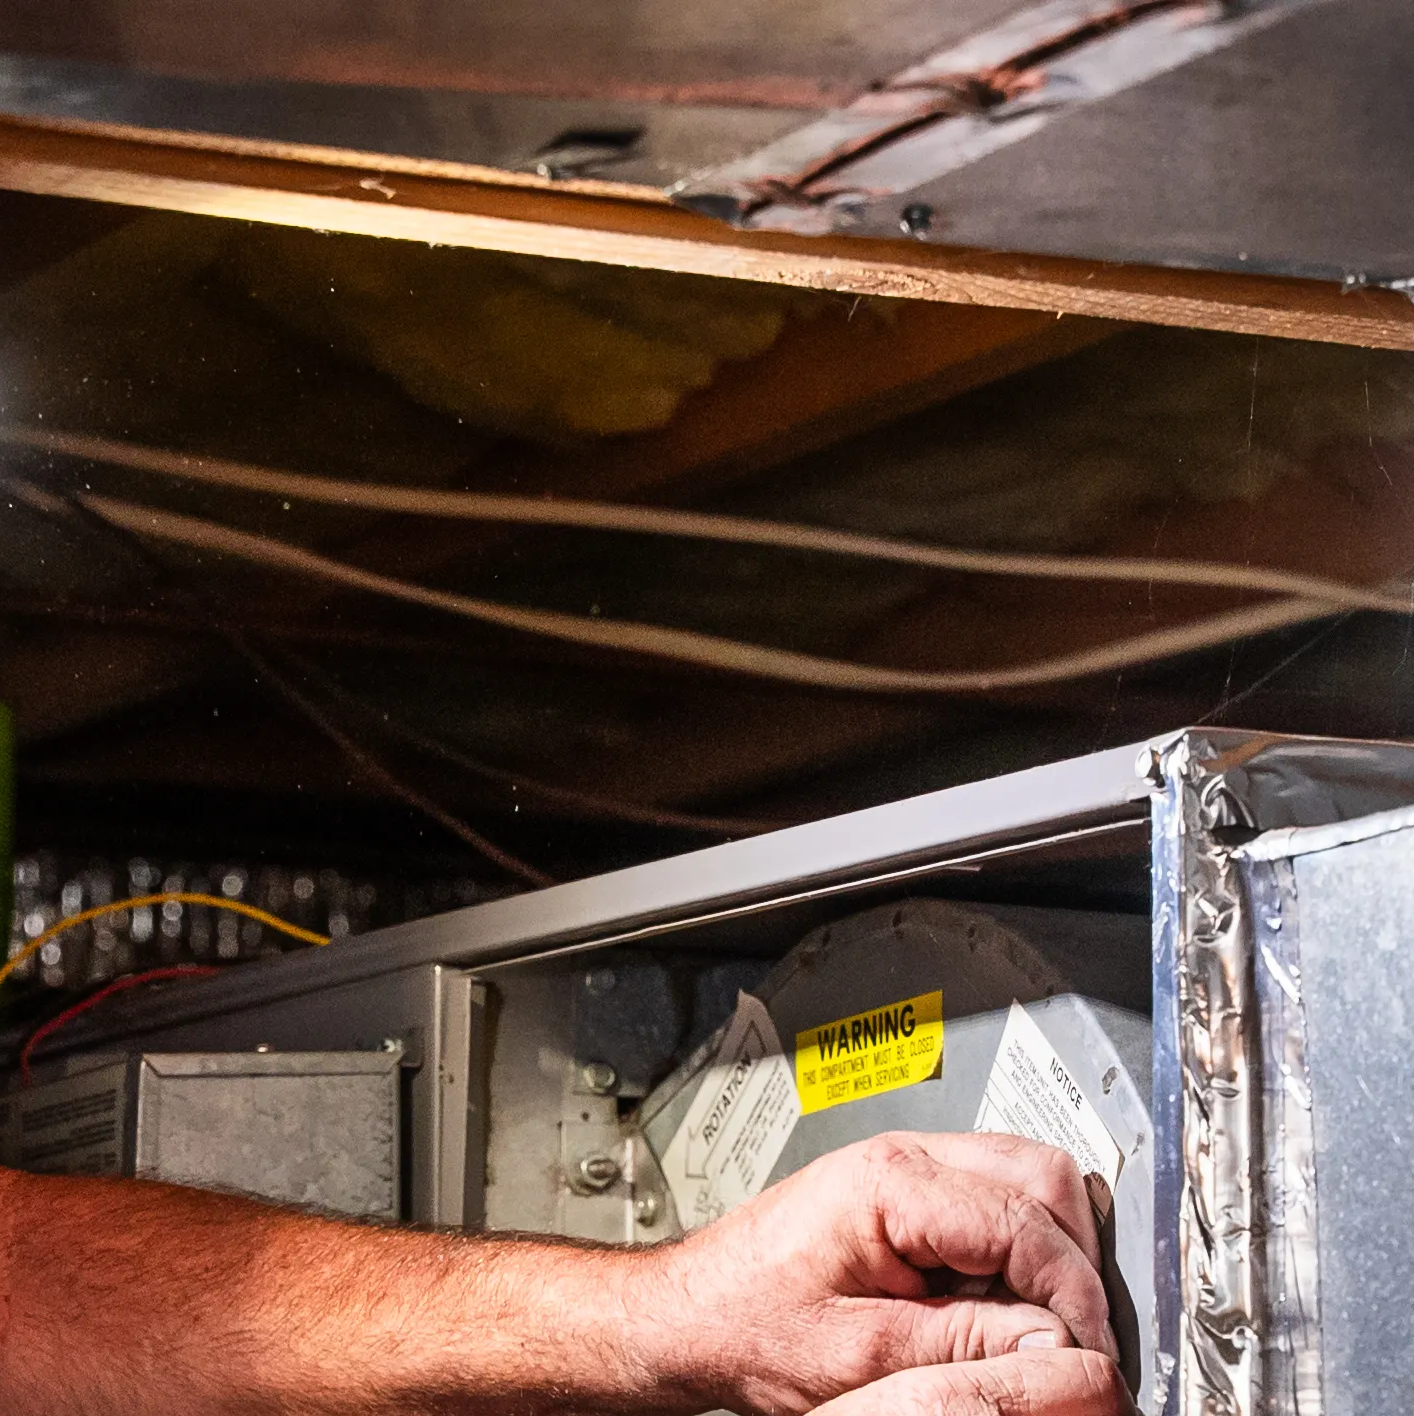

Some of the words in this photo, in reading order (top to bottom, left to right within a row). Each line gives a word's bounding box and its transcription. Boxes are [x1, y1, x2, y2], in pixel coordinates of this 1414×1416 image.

[803, 1069, 816, 1087] THIS
[820, 1055, 868, 1082] COMPARTMENT
[873, 1048, 891, 1067] MUST
[897, 1044, 906, 1061] BE
[910, 1036, 935, 1057] CLOSED
[817, 1004, 916, 1062] WARNING
[702, 1051, 752, 1146] ROTATION
[827, 1080, 849, 1100] EXCEPT
[853, 1074, 872, 1093] WHEN
[875, 1063, 909, 1087] SERVICING
[1007, 1047, 1030, 1082] CHECKED
[1029, 1079, 1040, 1096] FOR
[1040, 1093, 1076, 1148] CONFORMANCE
[1076, 1146, 1084, 1160] TO
[1011, 1070, 1022, 1088] AND
[1022, 1086, 1054, 1134] ENGINEERING
[1014, 1039, 1025, 1059] THIS
[1049, 1092, 1060, 1108] HAS
[1060, 1105, 1076, 1128] BEEN
[1074, 1125, 1106, 1172] THOROUGHLY
[1049, 1057, 1083, 1111] NOTICE
[1015, 1101, 1046, 1143] ACCEPTANC
